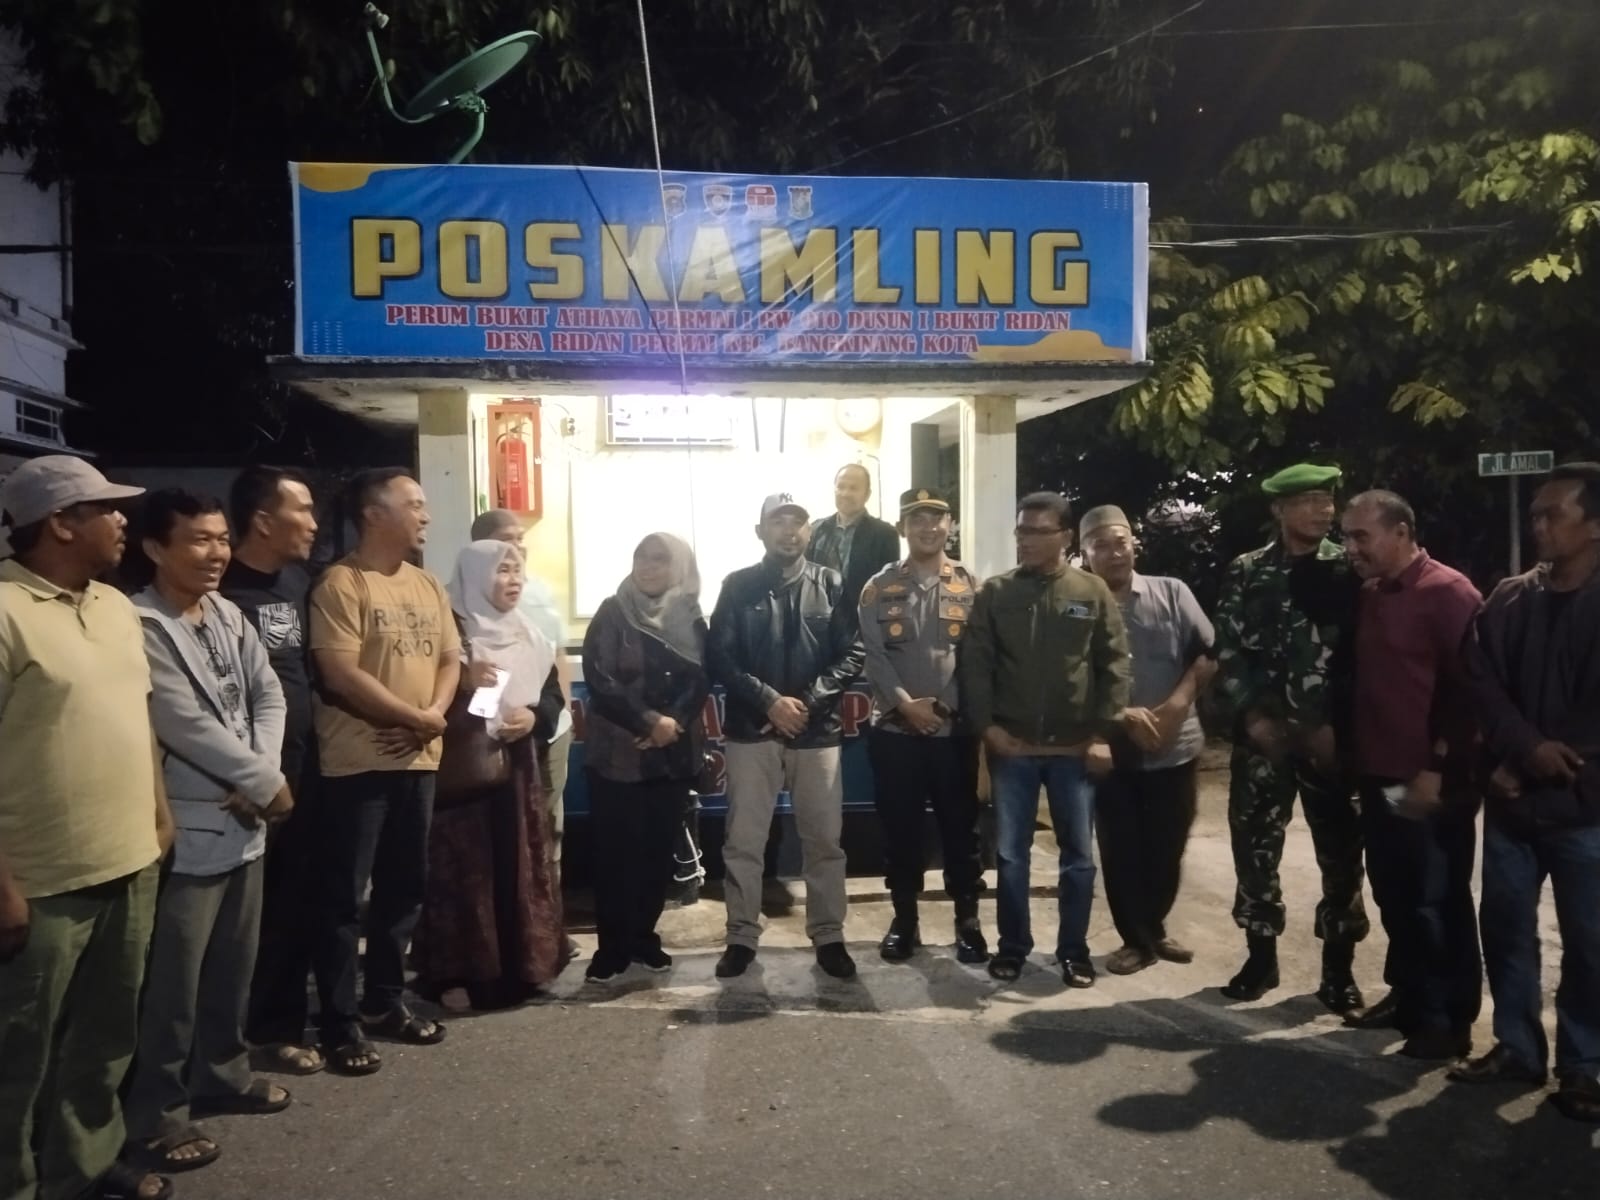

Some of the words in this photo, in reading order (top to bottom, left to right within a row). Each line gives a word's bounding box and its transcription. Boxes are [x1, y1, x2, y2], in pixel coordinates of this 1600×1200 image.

[351, 216, 1090, 306] POSKAMLING
[386, 304, 470, 326] PERUM
[476, 305, 549, 327] BUKIT
[556, 307, 643, 329] ATHAYA
[847, 311, 911, 331] DUSUN
[934, 311, 999, 331] BUKIT
[1004, 311, 1071, 332] RIDAN
[485, 330, 545, 352] DESA
[551, 332, 624, 353] RIDAN
[630, 333, 718, 354] PERMAI
[777, 333, 917, 354] BANGKINANG
[922, 334, 980, 354] KOTA
